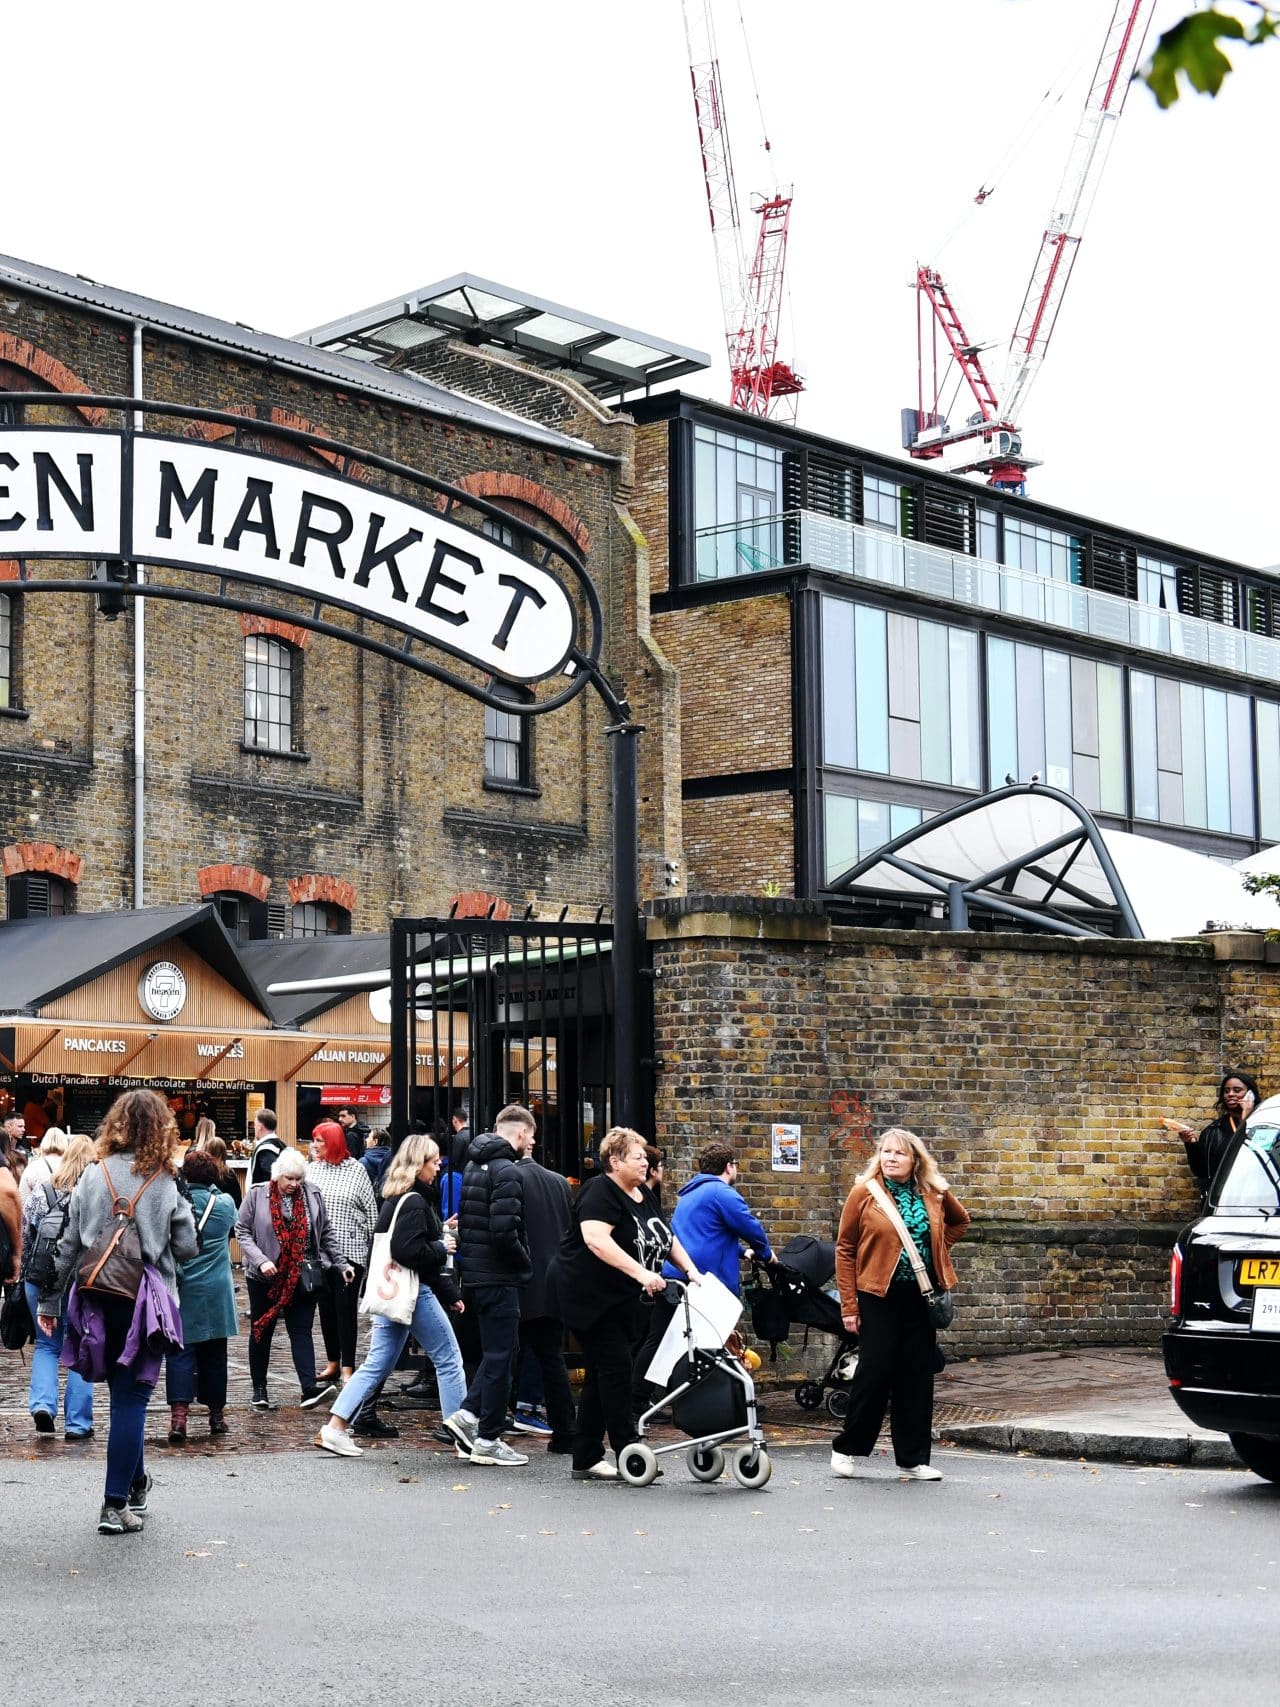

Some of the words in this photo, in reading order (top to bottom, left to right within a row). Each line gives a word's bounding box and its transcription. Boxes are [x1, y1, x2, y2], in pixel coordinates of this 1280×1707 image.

[156, 460, 547, 652] MARKET
[151, 987, 180, 996] heaven
[64, 1037, 126, 1053] PANCAKES
[348, 1051, 386, 1063] PIADINA
[415, 1054, 446, 1066] STEK
[31, 1073, 58, 1084] Dutch
[60, 1075, 99, 1086] Pancakes
[108, 1076, 142, 1088] Belgian
[143, 1078, 186, 1088] Chocolate
[196, 1079, 225, 1089] Bubble
[225, 1080, 255, 1090] Waffles
[1247, 1260, 1280, 1280] LR7
